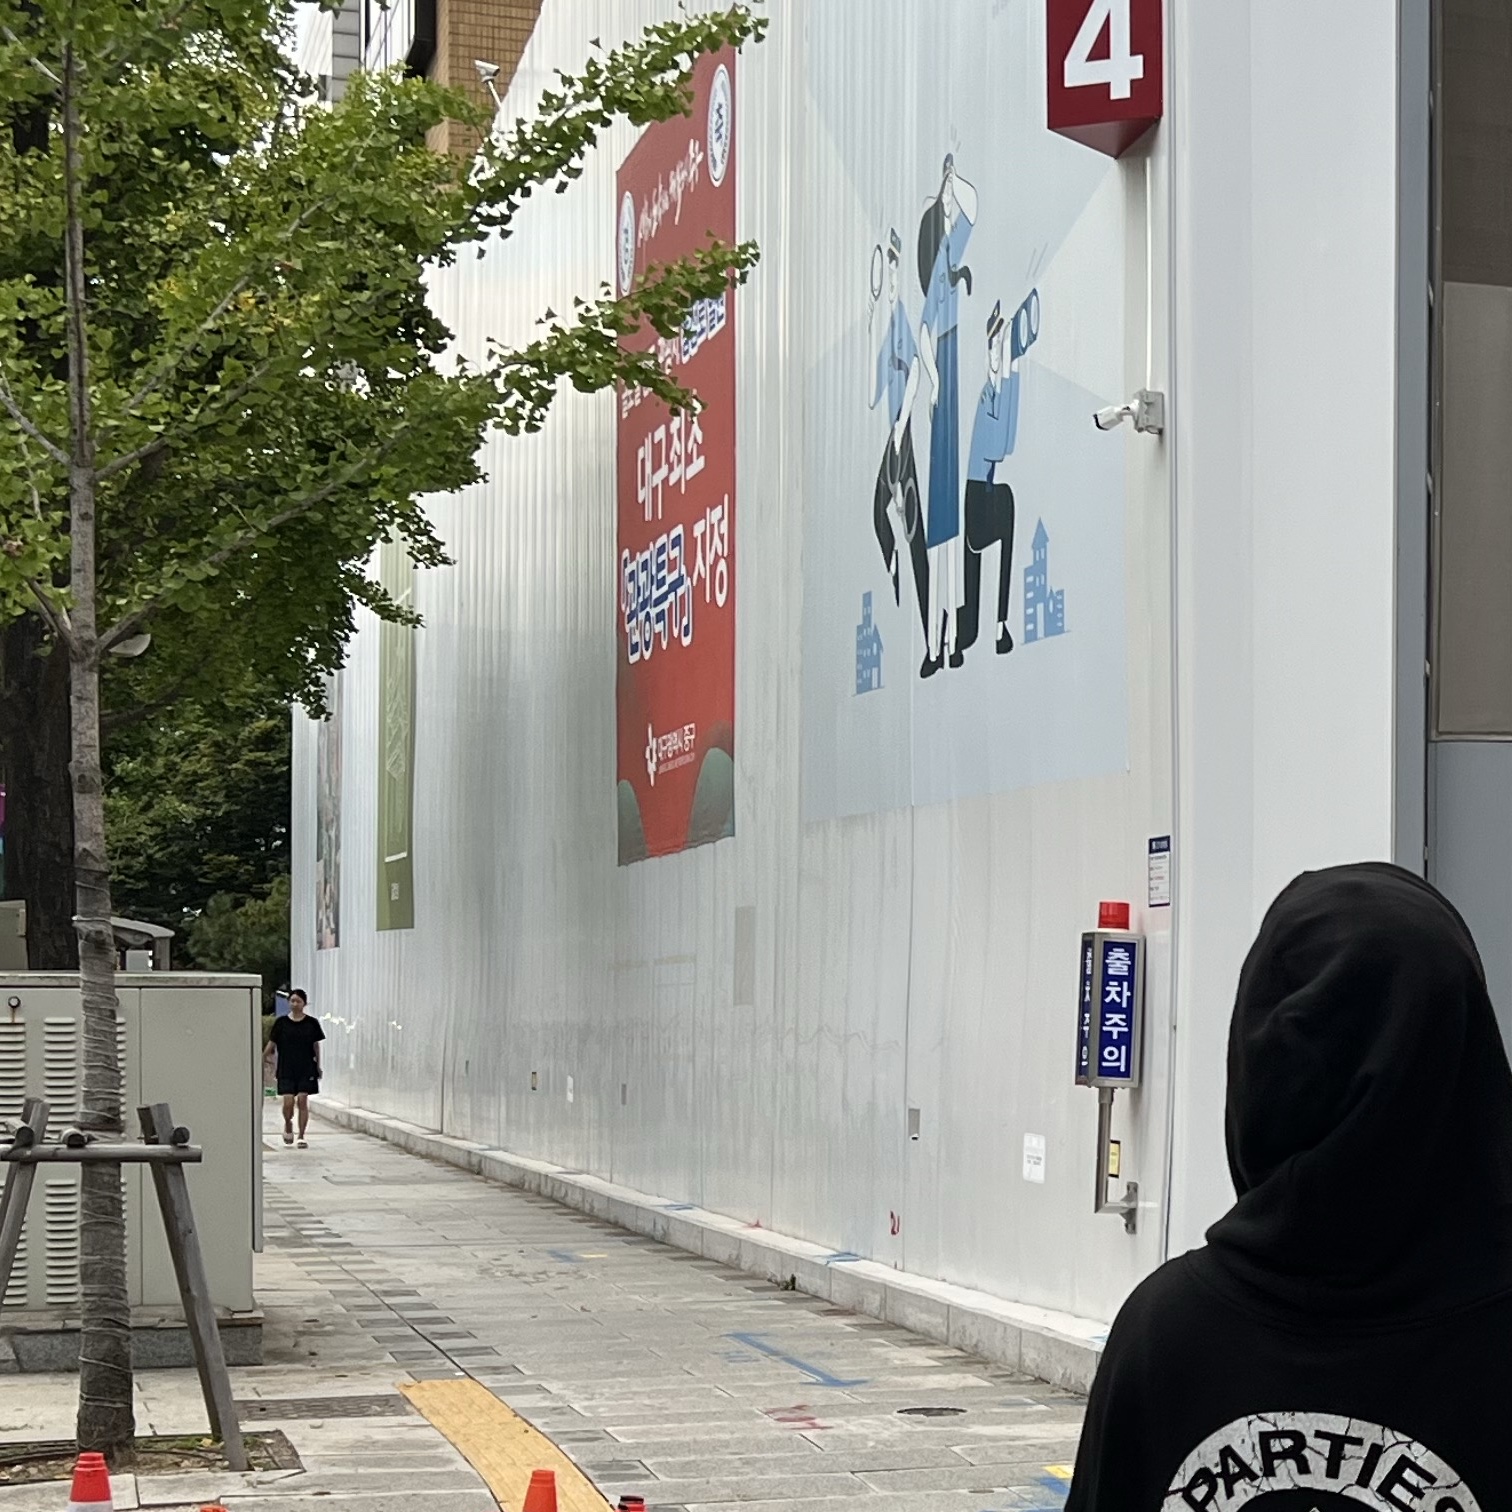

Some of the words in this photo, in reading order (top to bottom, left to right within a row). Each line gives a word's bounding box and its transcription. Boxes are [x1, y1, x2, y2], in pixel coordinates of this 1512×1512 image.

[1064, 0, 1144, 100] 4
[692, 494, 729, 608] 지정
[1101, 947, 1132, 1073] 출차주의
